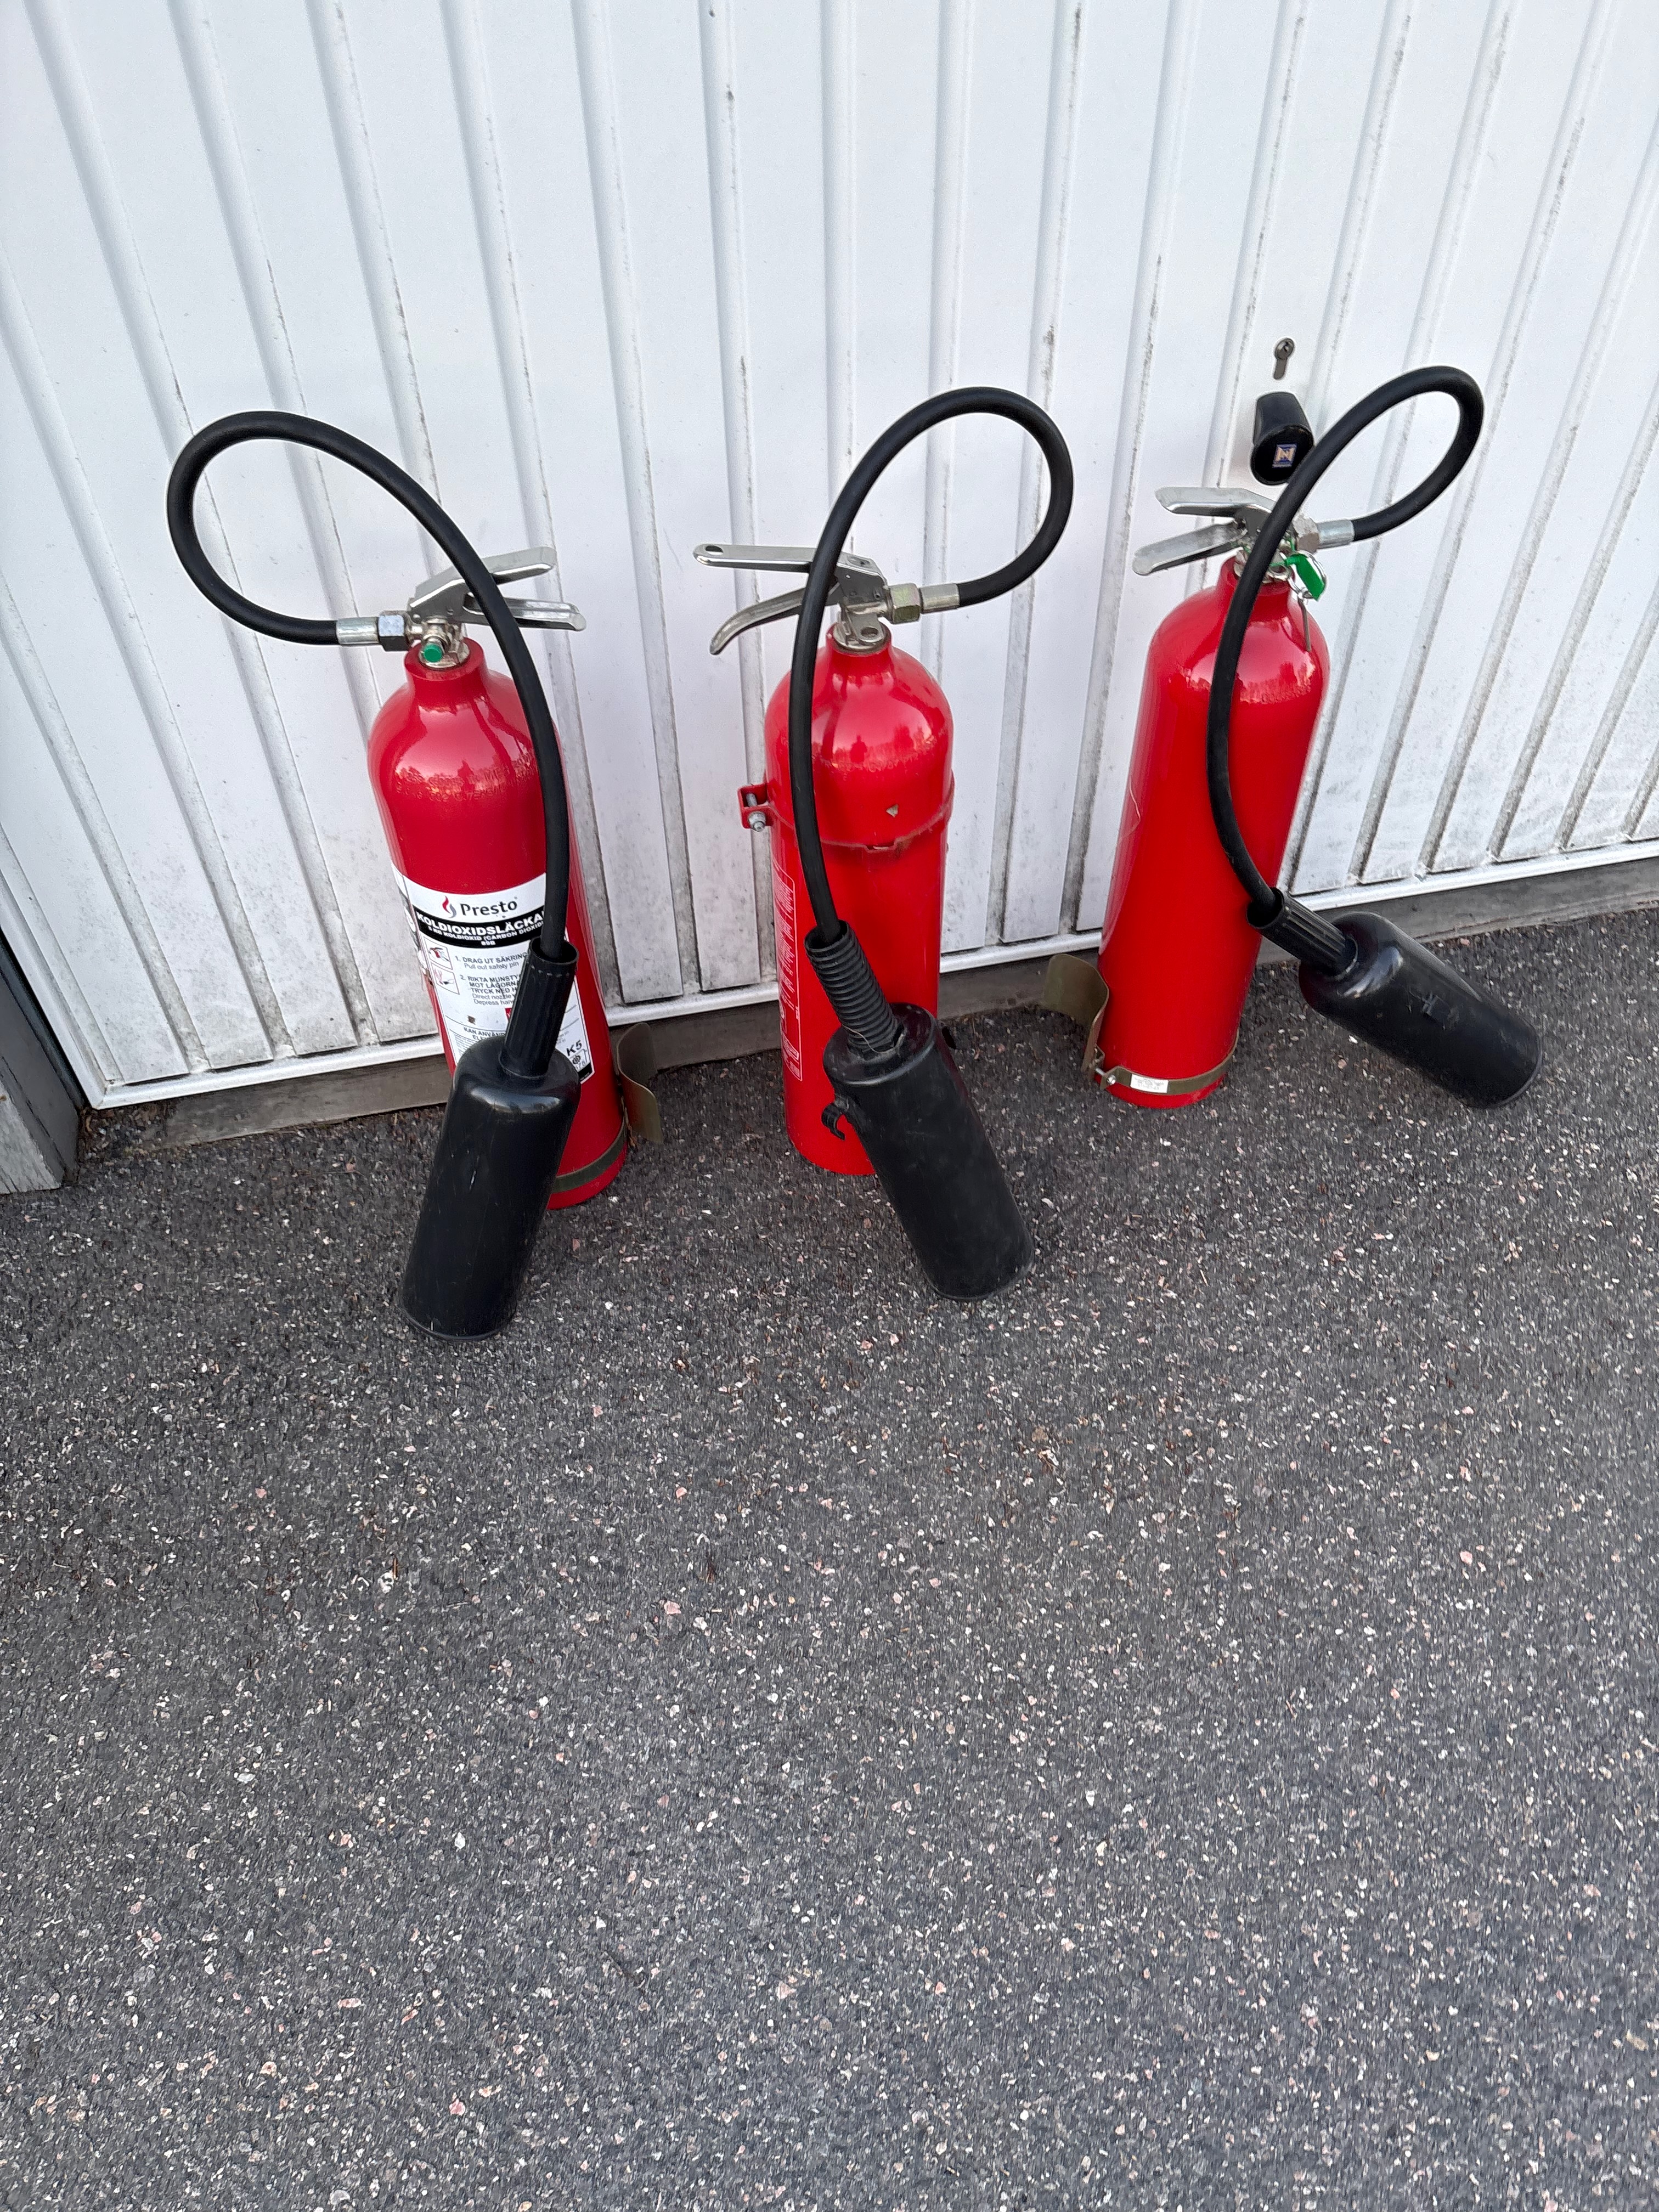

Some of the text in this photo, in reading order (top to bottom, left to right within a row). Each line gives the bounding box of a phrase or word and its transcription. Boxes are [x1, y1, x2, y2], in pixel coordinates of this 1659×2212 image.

[460, 900, 518, 916] Presto
[443, 932, 482, 941] KOLDIOXID
[489, 974, 521, 983] MUNSTY
[566, 1040, 583, 1057] K5
